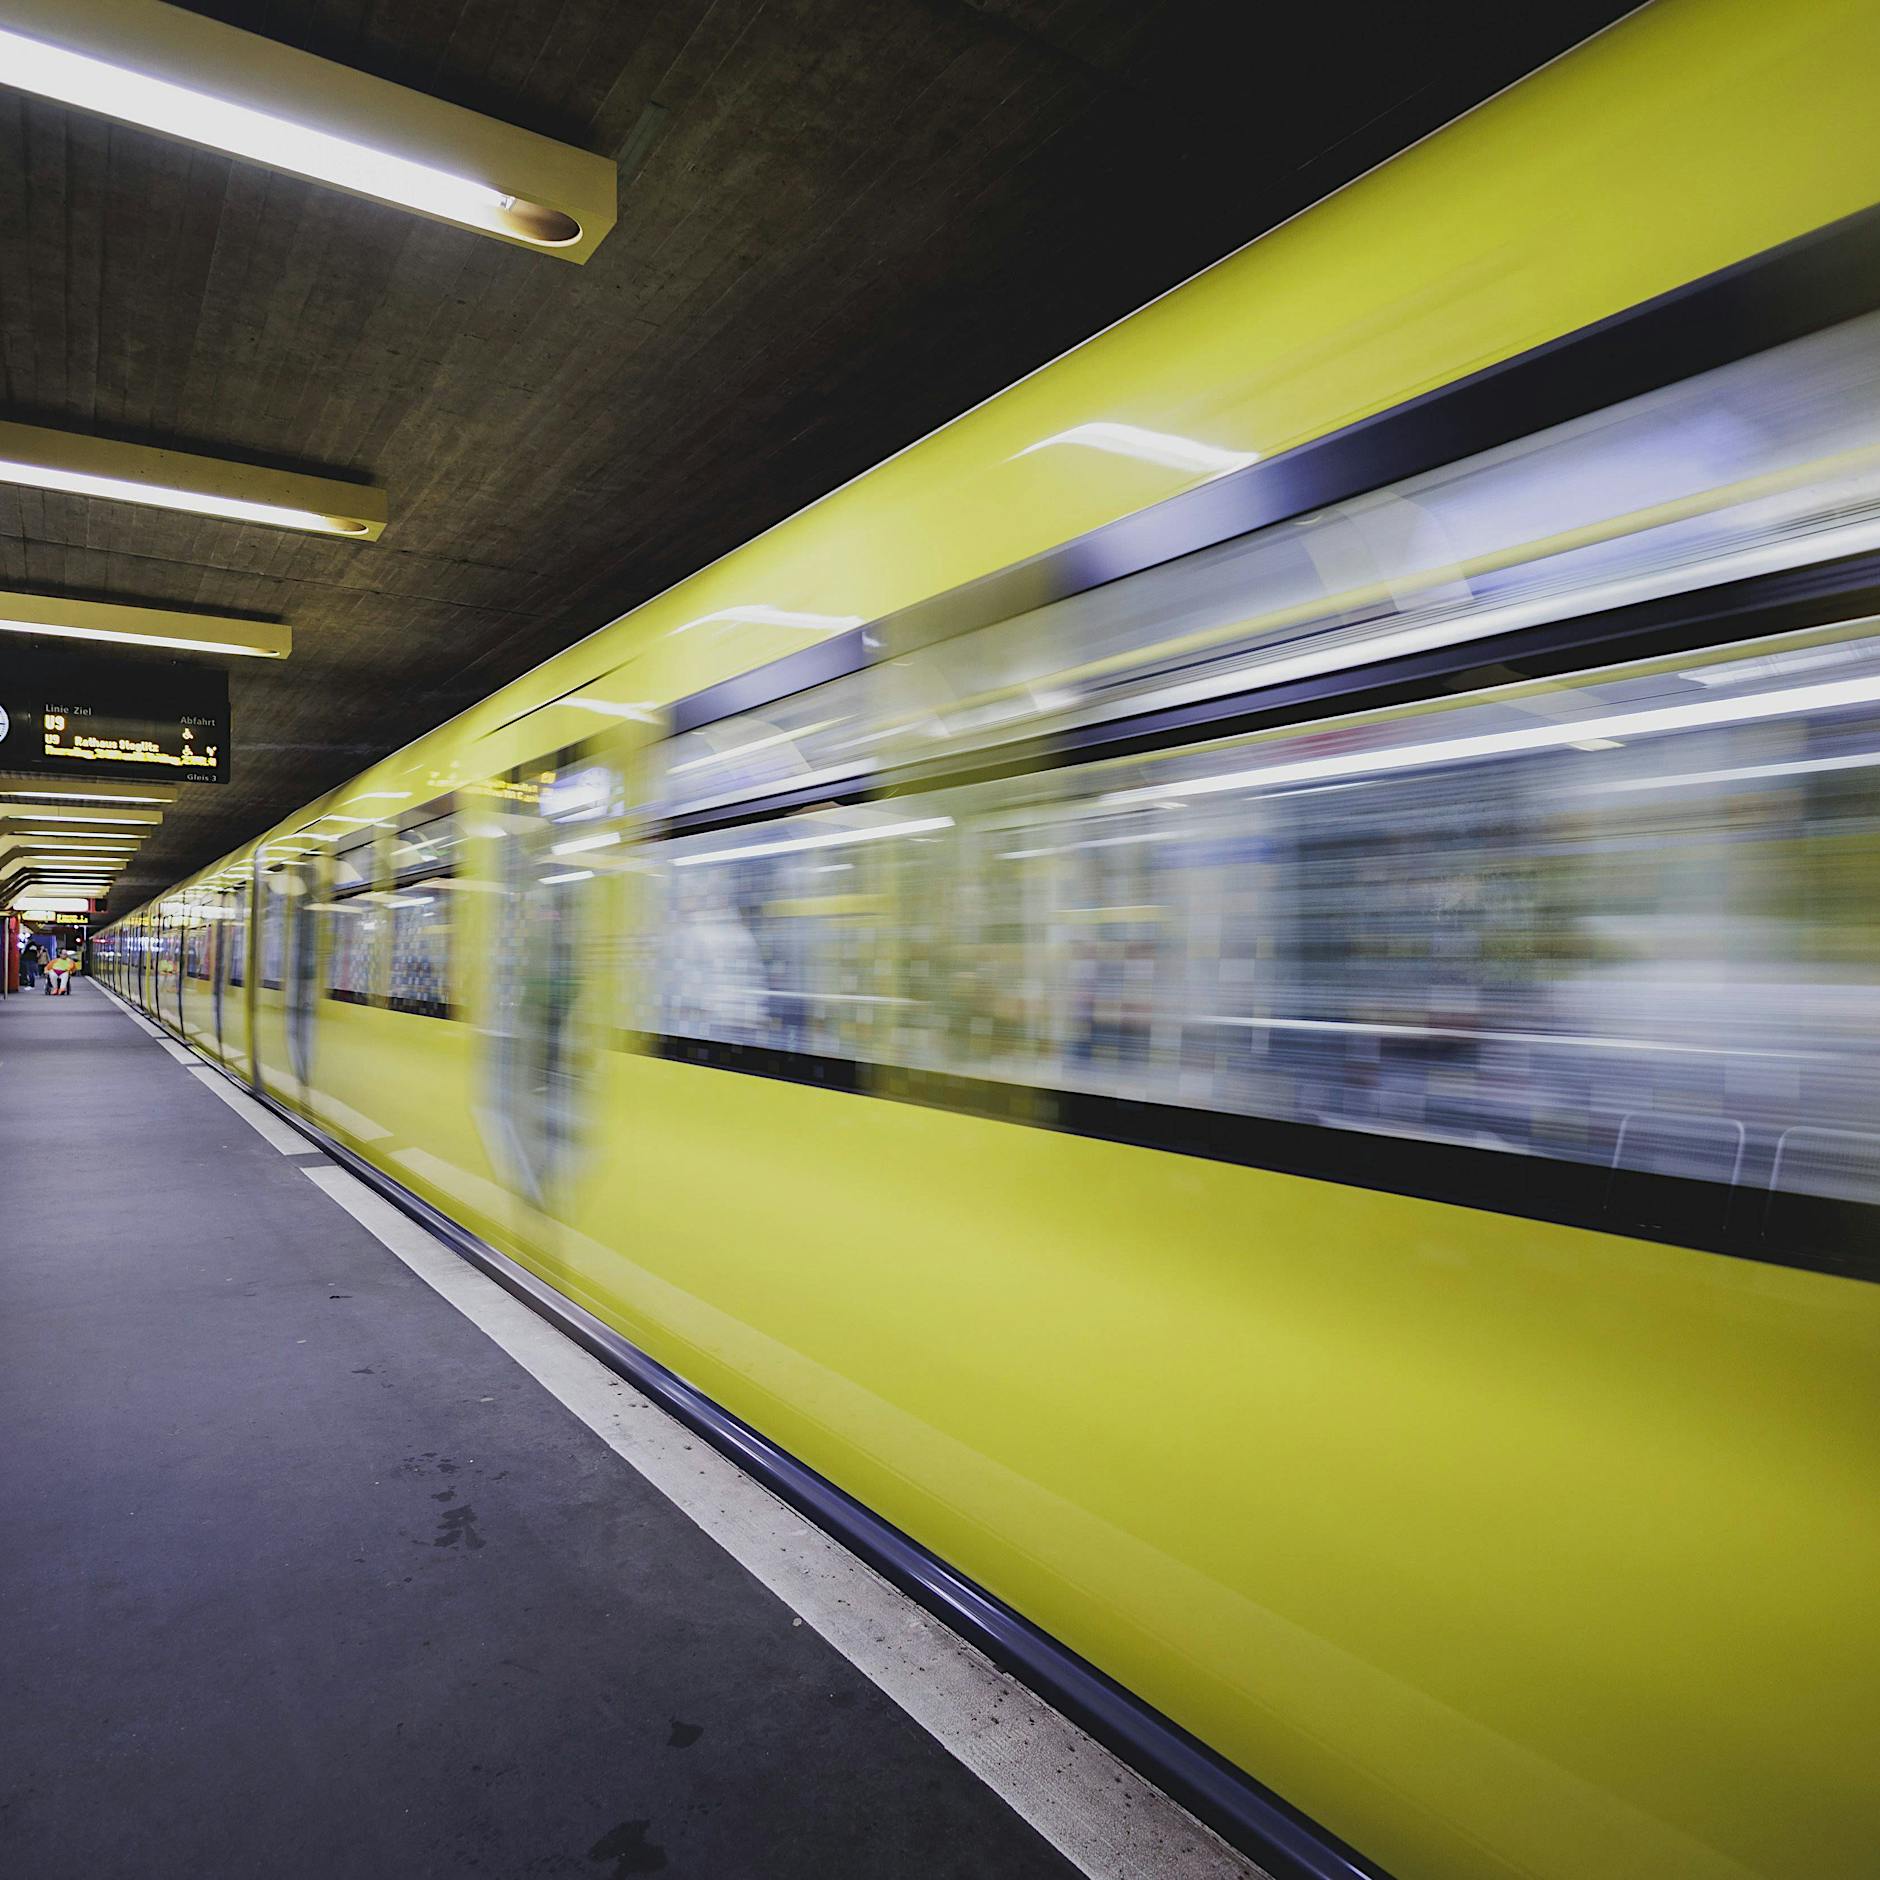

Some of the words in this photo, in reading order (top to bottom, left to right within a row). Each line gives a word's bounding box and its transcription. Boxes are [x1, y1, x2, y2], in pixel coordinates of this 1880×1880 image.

[45, 704, 70, 714] Linie
[73, 706, 92, 715] Ziel
[44, 714, 65, 731] U9
[180, 716, 216, 726] Abfahrt
[186, 773, 209, 782] Gleis
[211, 774, 217, 782] 3
